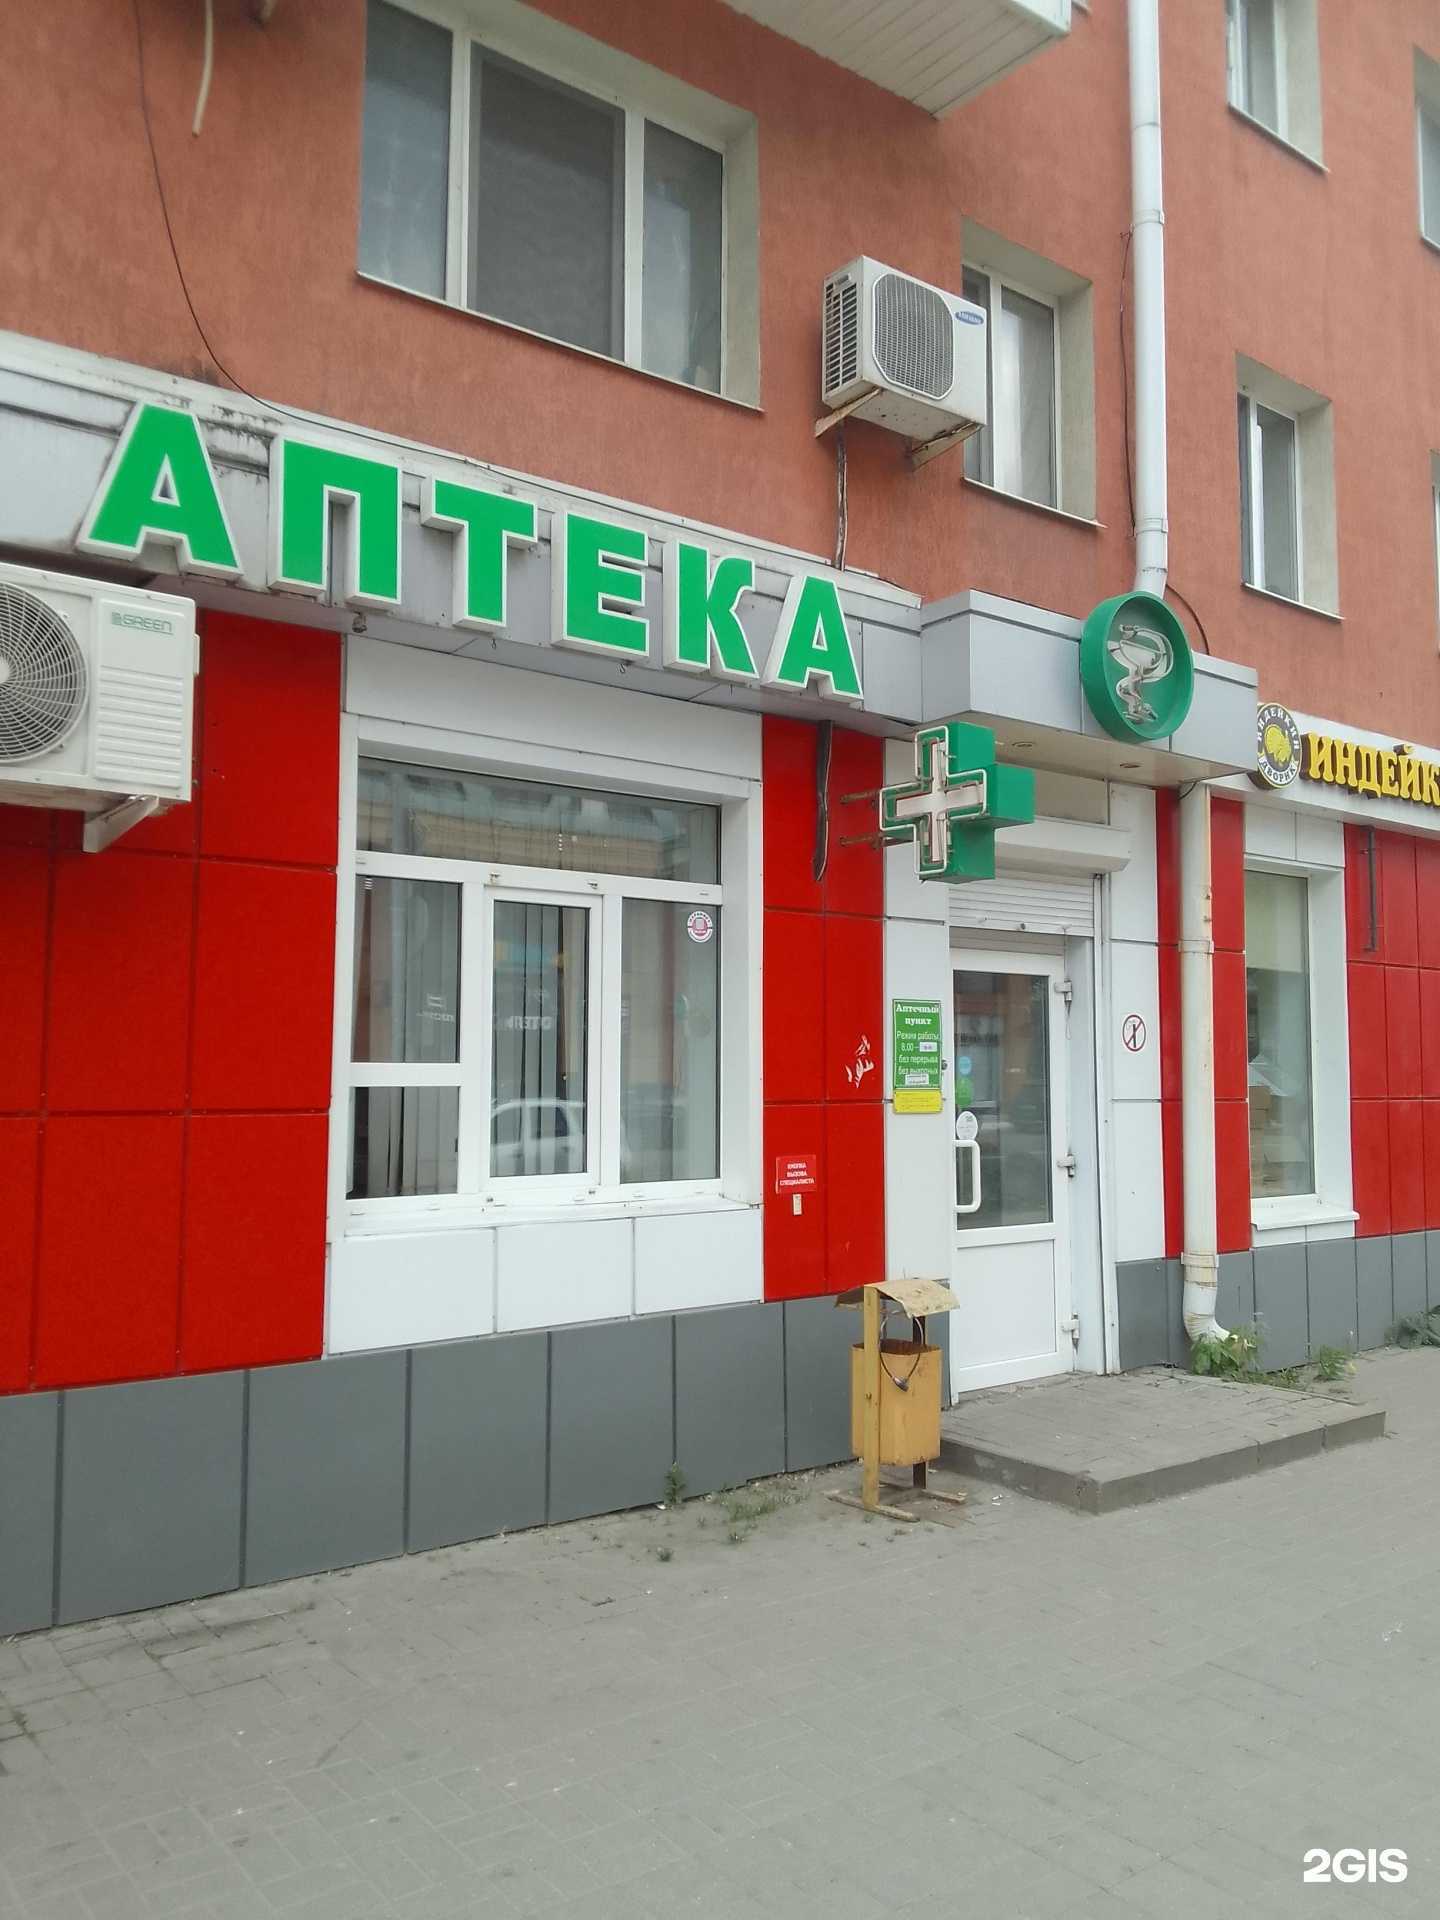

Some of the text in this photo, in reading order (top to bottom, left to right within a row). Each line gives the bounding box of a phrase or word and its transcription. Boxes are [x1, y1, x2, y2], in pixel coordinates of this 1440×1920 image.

[76, 401, 864, 703] АПТЕКА
[896, 1003, 940, 1014] Аптечный
[905, 1017, 932, 1026] пункт
